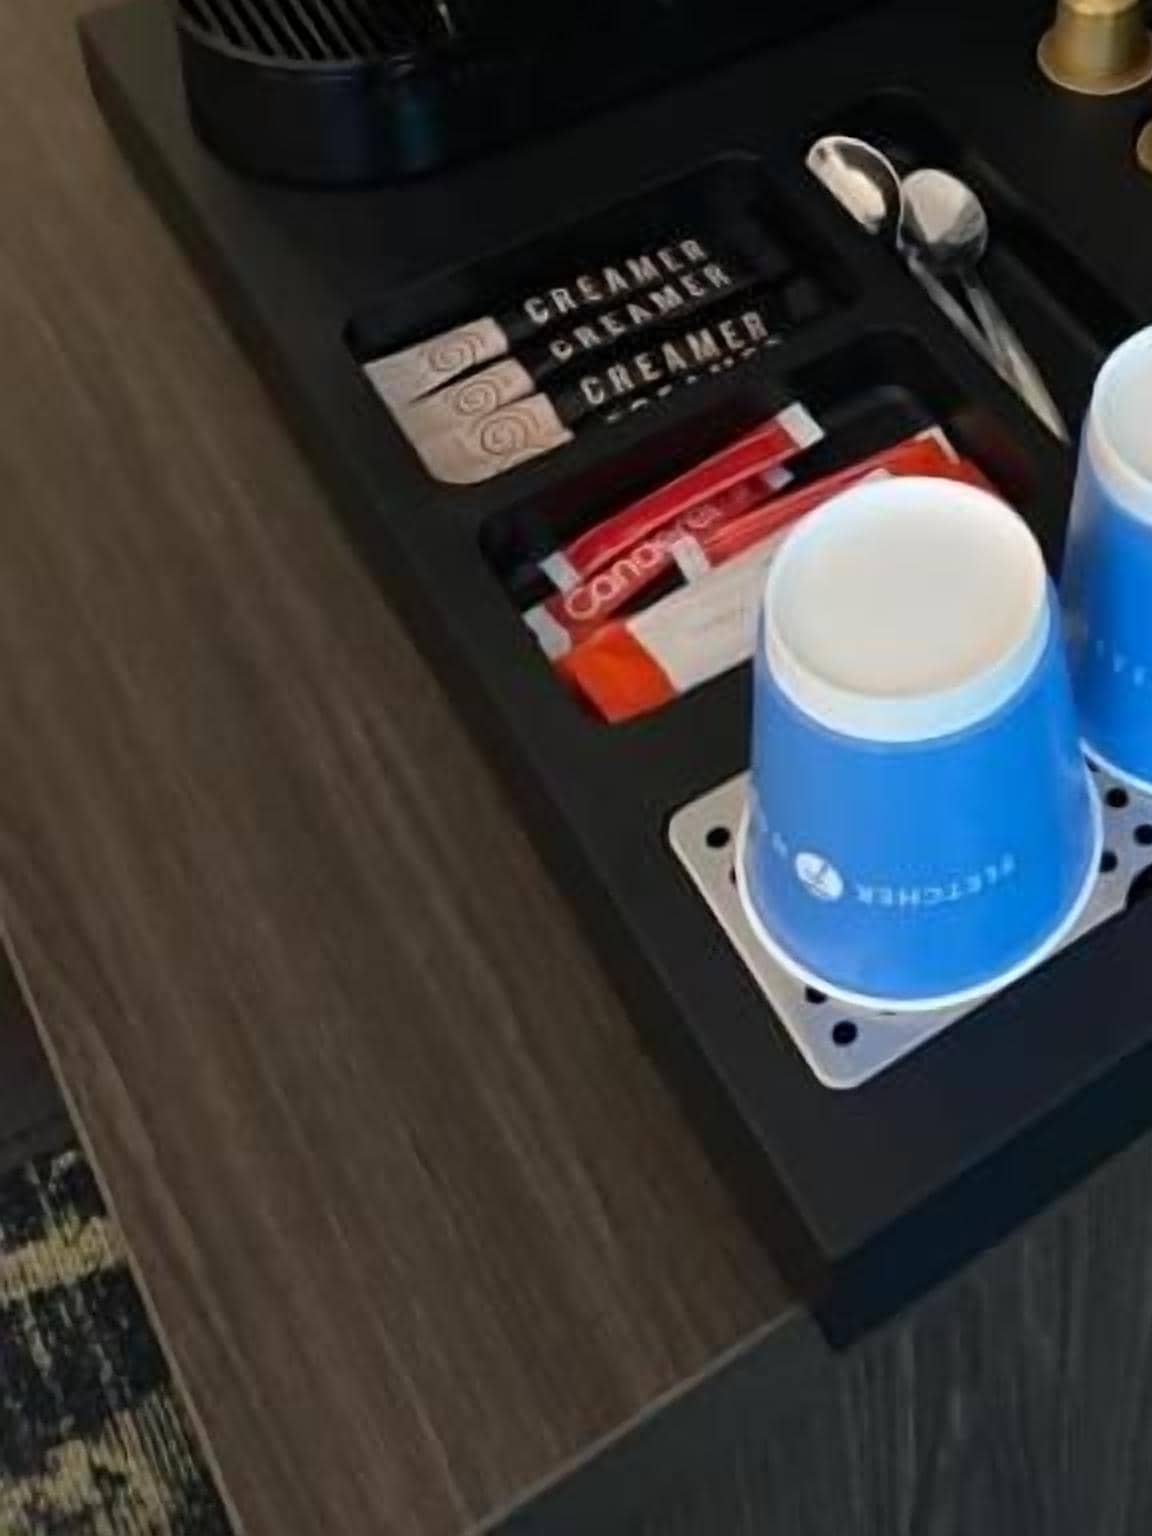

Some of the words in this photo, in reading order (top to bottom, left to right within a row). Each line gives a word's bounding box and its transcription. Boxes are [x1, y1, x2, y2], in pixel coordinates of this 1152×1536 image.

[522, 238, 709, 325] CREAMER
[549, 264, 733, 362] CREAMER
[578, 311, 771, 406] CREAMER
